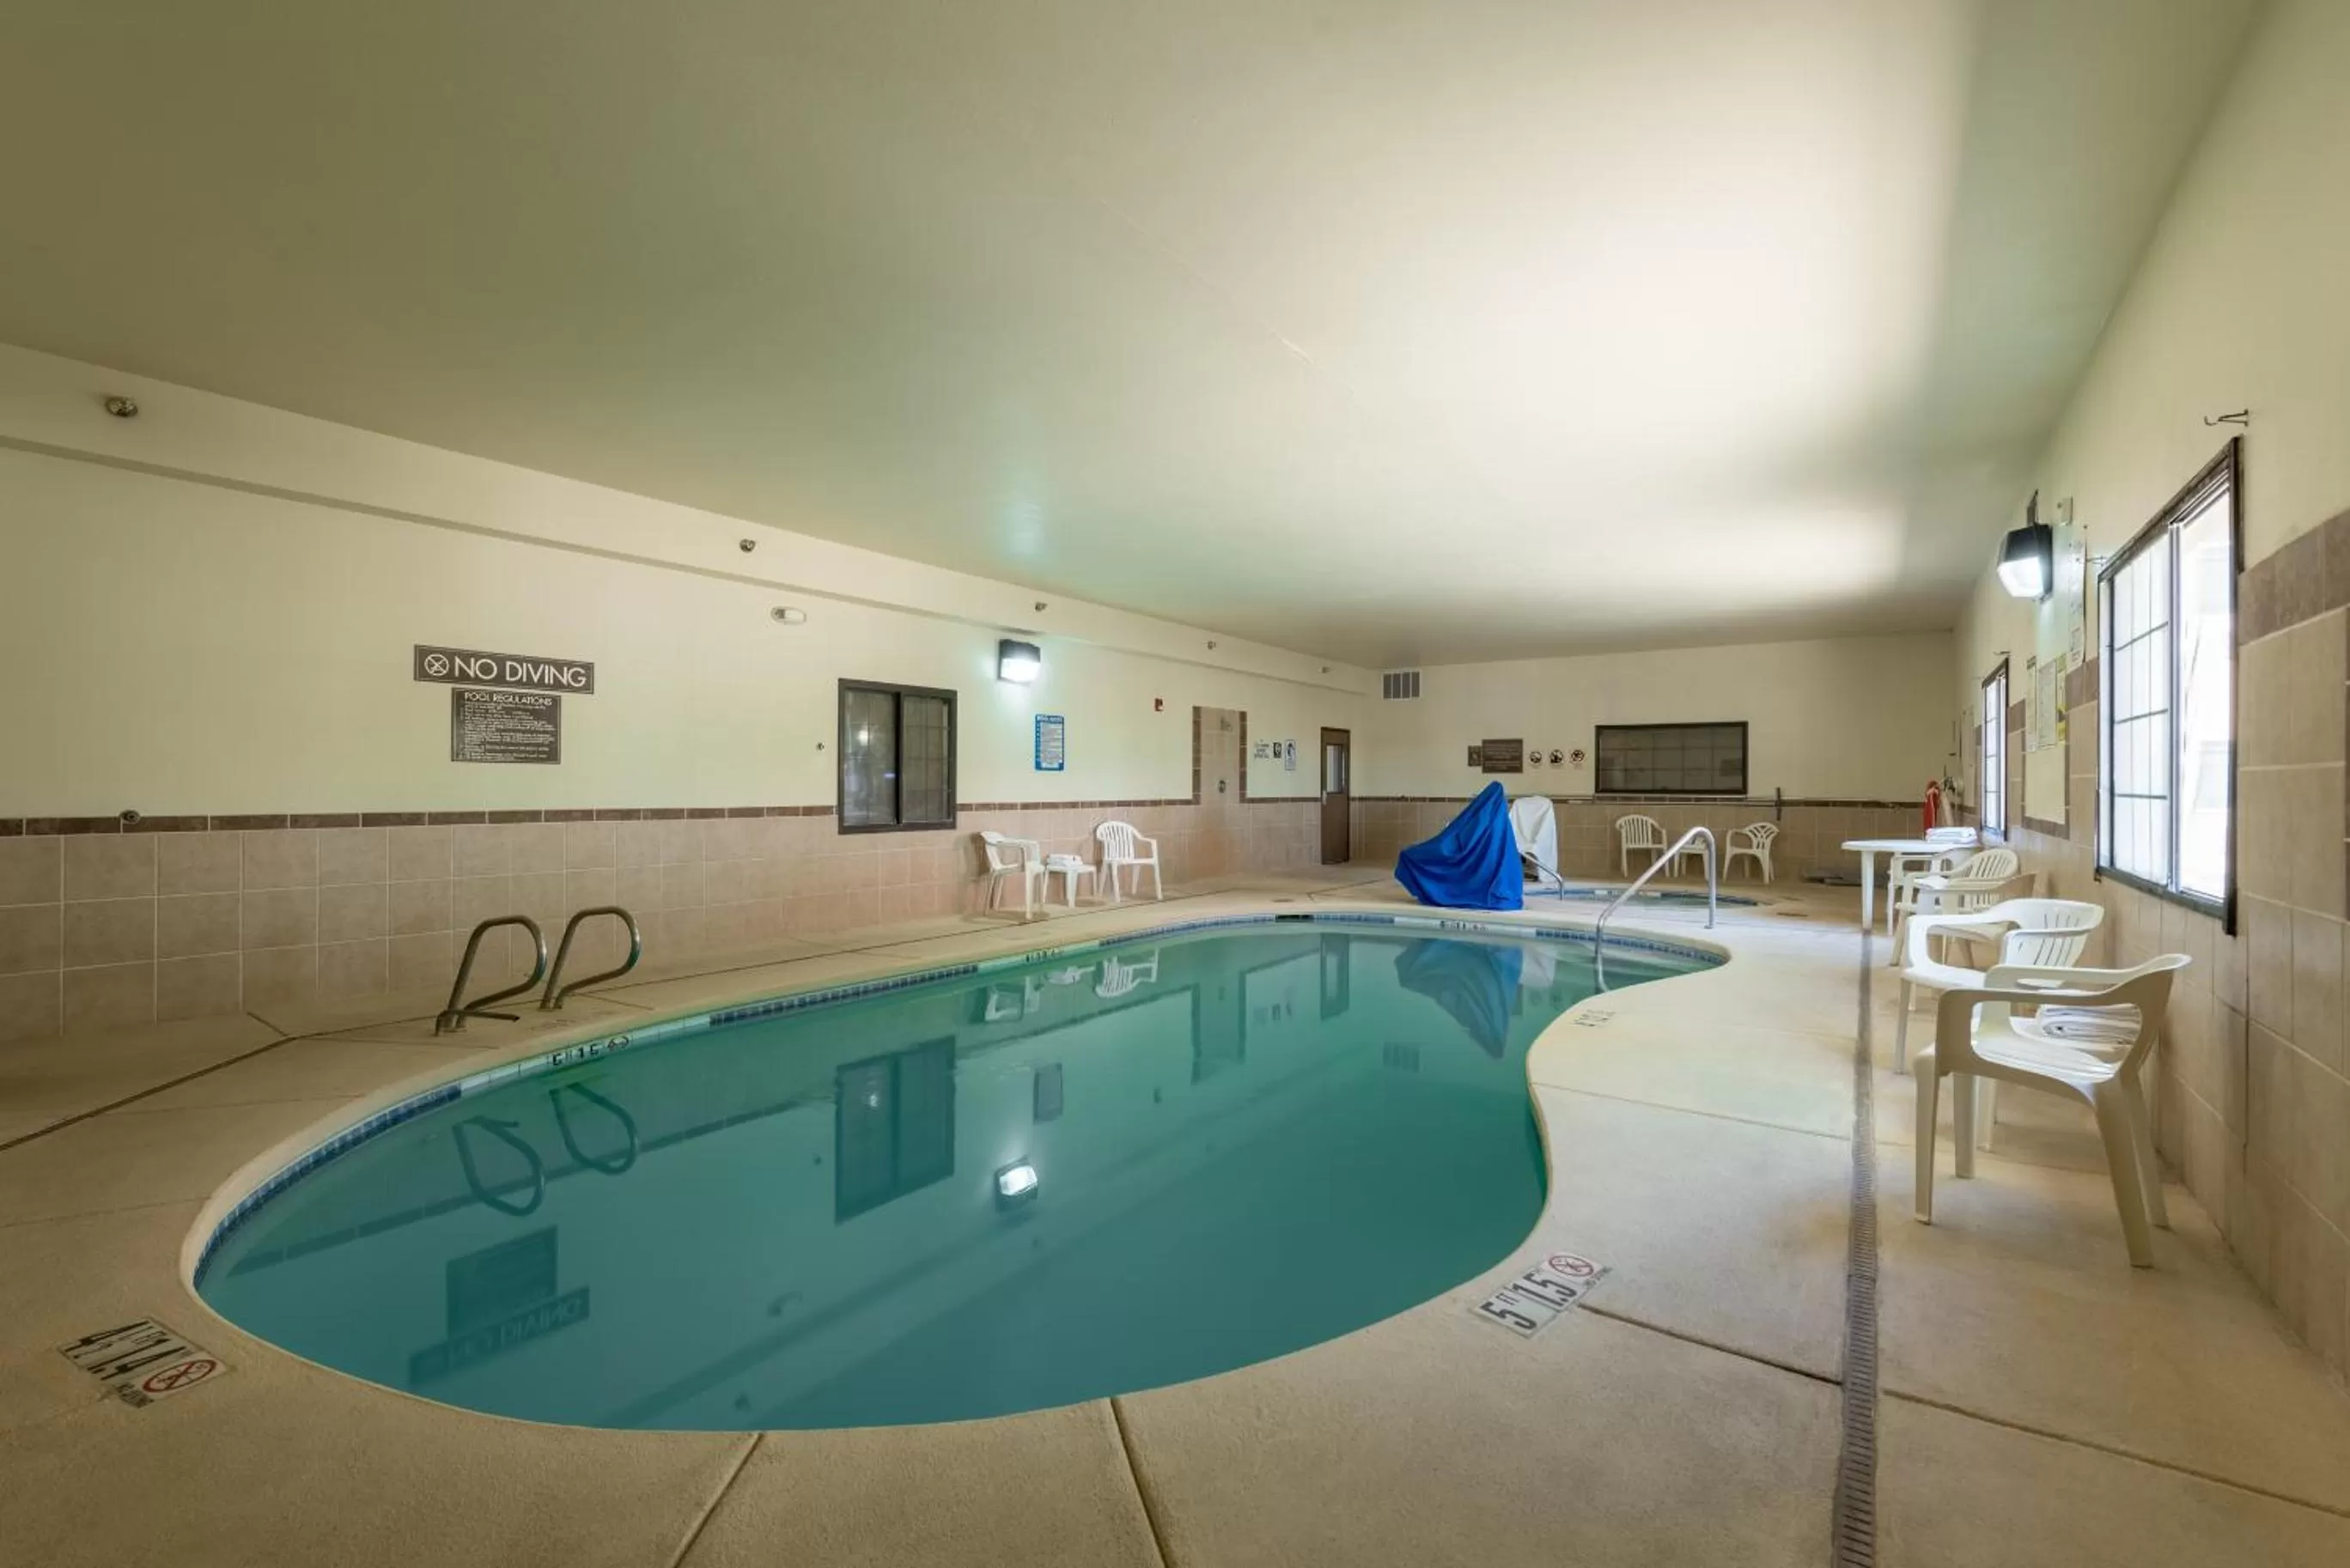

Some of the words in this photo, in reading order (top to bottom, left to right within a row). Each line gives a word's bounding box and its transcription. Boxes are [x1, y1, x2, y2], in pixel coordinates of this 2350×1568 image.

[454, 655, 498, 680] NO
[505, 660, 588, 687] DIVING
[464, 692, 490, 702] POOL
[493, 693, 553, 706] REGULATIONS
[1480, 1301, 1537, 1330] 5
[1512, 1273, 1578, 1308] 1.5
